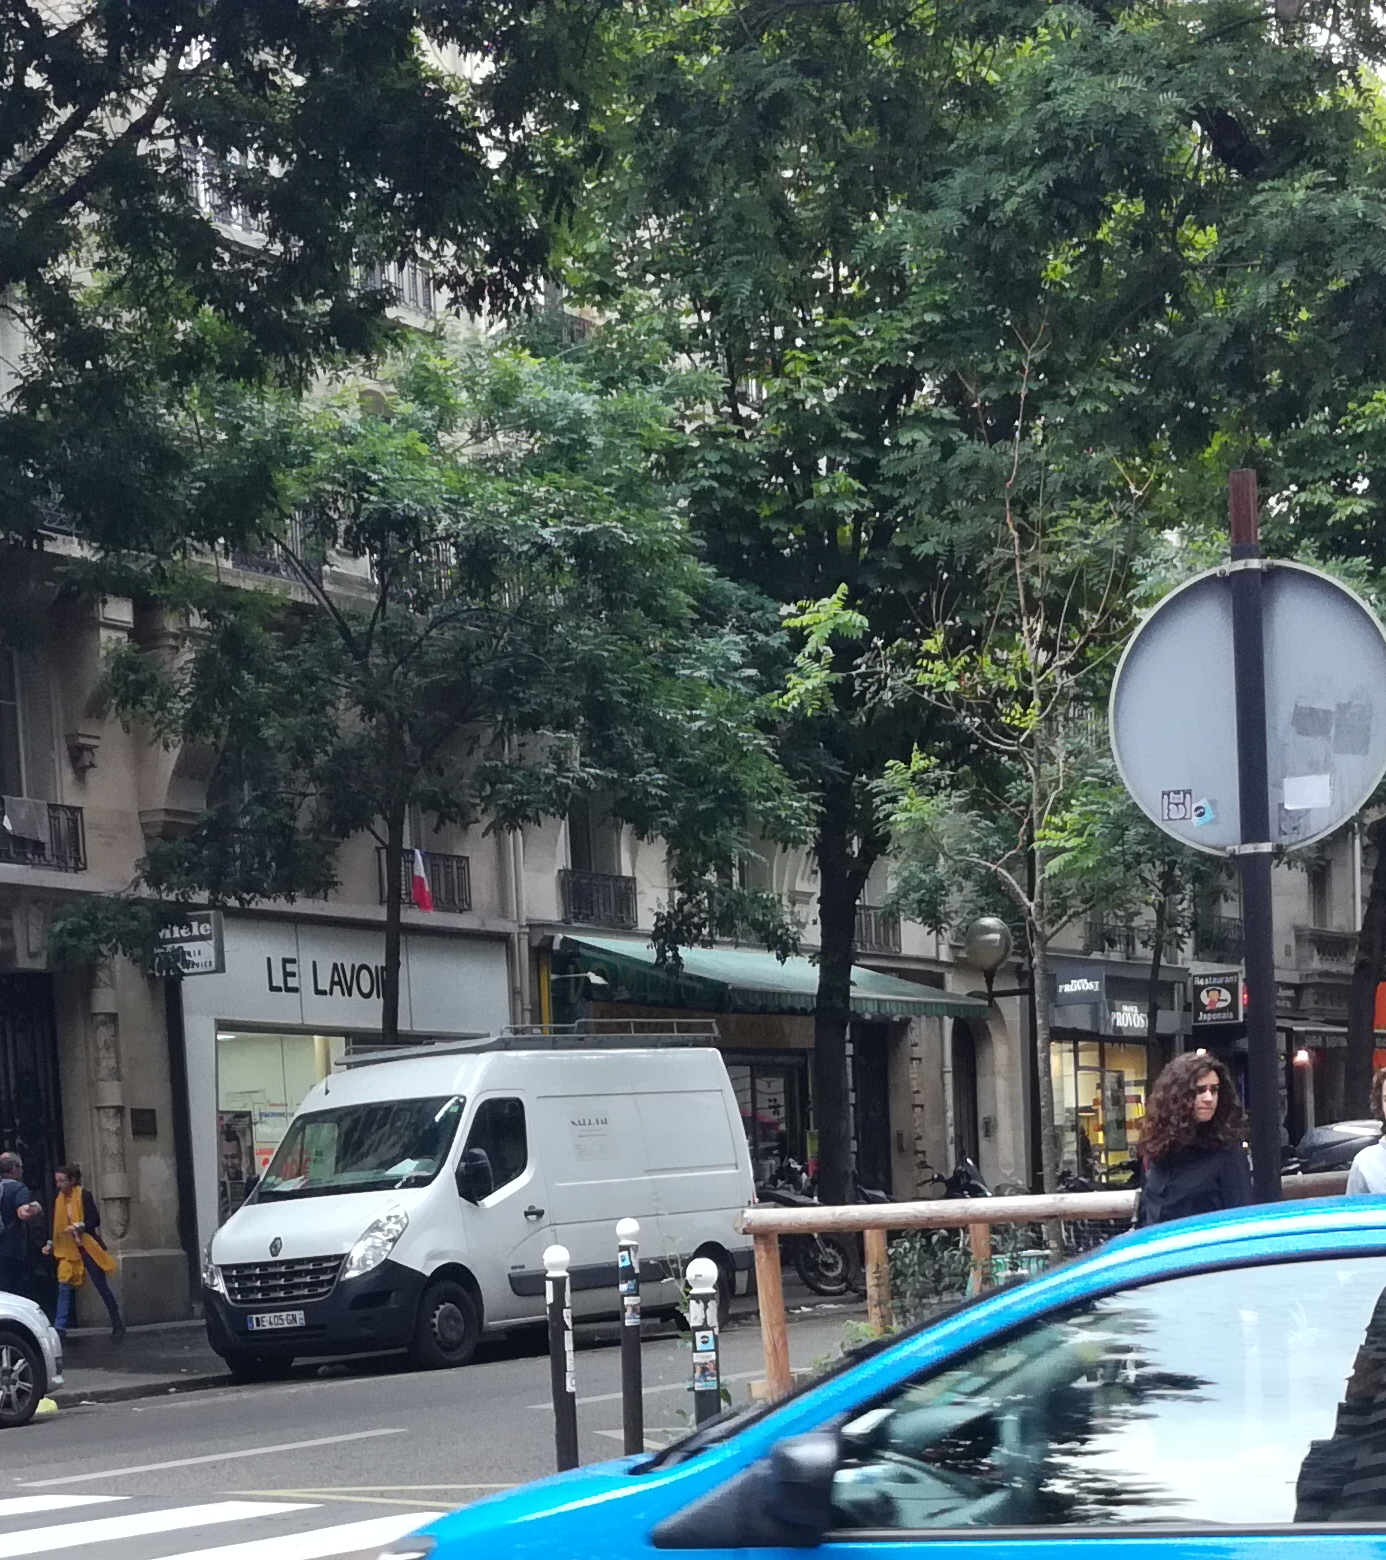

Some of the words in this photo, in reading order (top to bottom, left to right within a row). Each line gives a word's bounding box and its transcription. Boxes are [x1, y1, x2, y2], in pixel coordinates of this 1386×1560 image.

[266, 956, 300, 993] LE
[312, 960, 389, 999] LAVOI
[1194, 974, 1238, 985] Restaurant
[1058, 980, 1101, 994] PROVOST
[1198, 1011, 1234, 1022] Japonais
